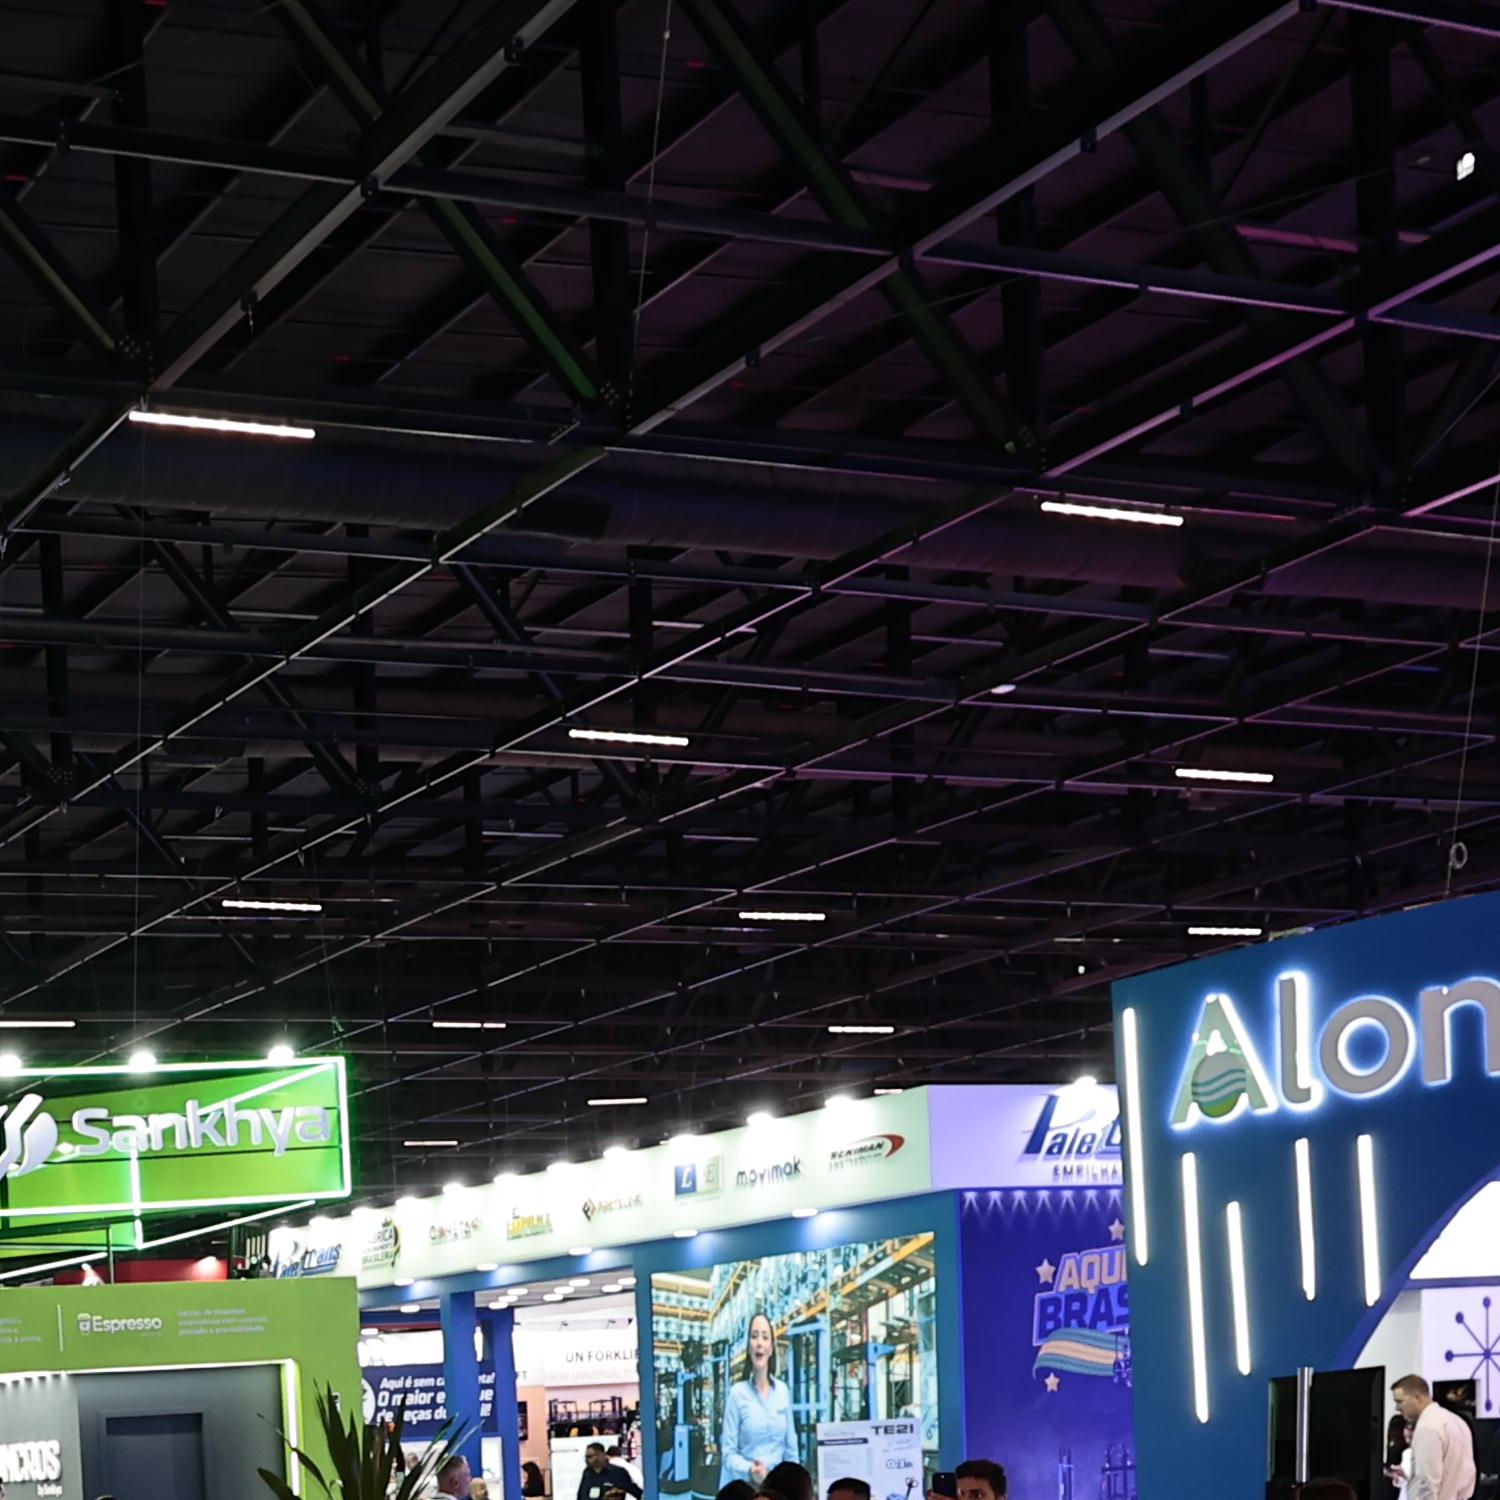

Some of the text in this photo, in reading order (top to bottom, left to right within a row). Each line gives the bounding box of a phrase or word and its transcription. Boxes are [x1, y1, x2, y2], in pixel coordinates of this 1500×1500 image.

[71, 1099, 331, 1156] Sankhya
[92, 1316, 163, 1334] Espresso
[565, 1351, 584, 1363] UN
[380, 1376, 404, 1389] Aqui
[413, 1377, 435, 1388] sem
[378, 1392, 389, 1406] O
[403, 1409, 432, 1425] eças
[871, 1423, 915, 1436] TE21
